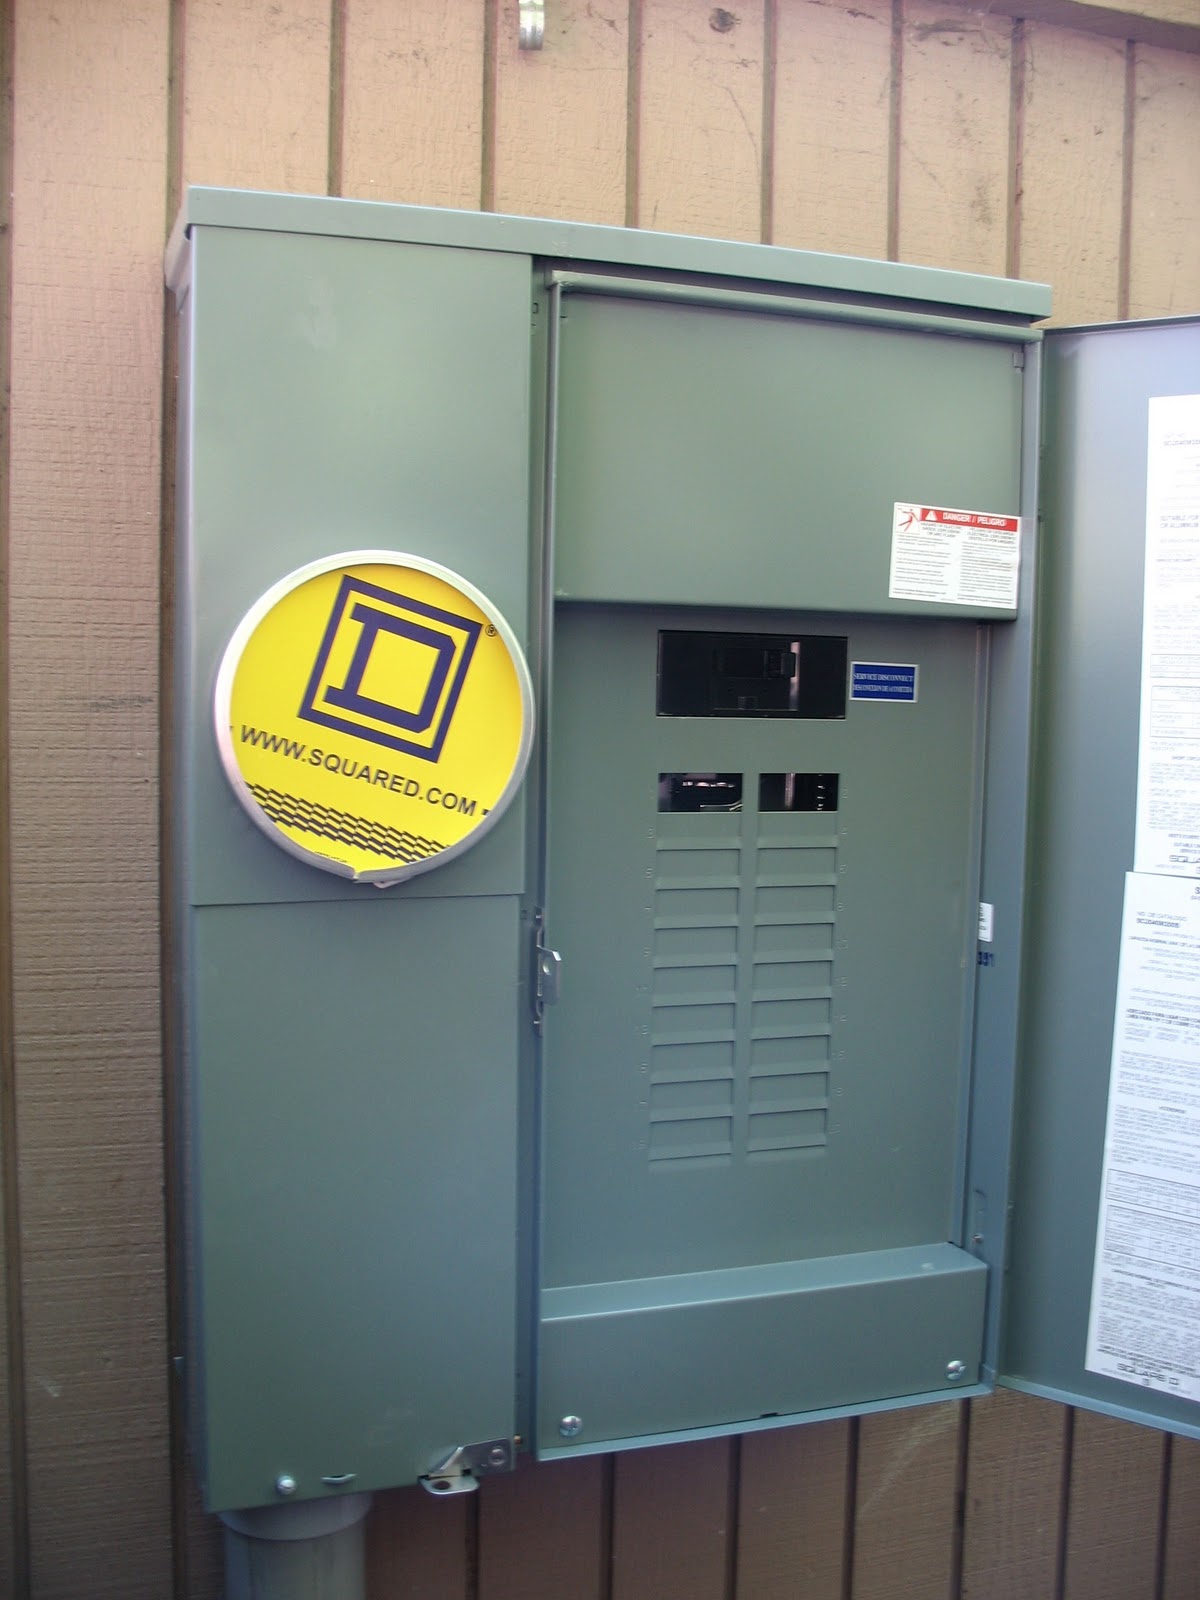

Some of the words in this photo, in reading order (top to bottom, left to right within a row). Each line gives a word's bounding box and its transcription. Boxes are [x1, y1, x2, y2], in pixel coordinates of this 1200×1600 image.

[943, 512, 971, 522] DANGER
[977, 516, 1007, 526] PELIGRO
[853, 673, 878, 681] SERVICE
[878, 674, 913, 682] DISCONNECT
[241, 725, 477, 817] WWW.SQUARED.COM
